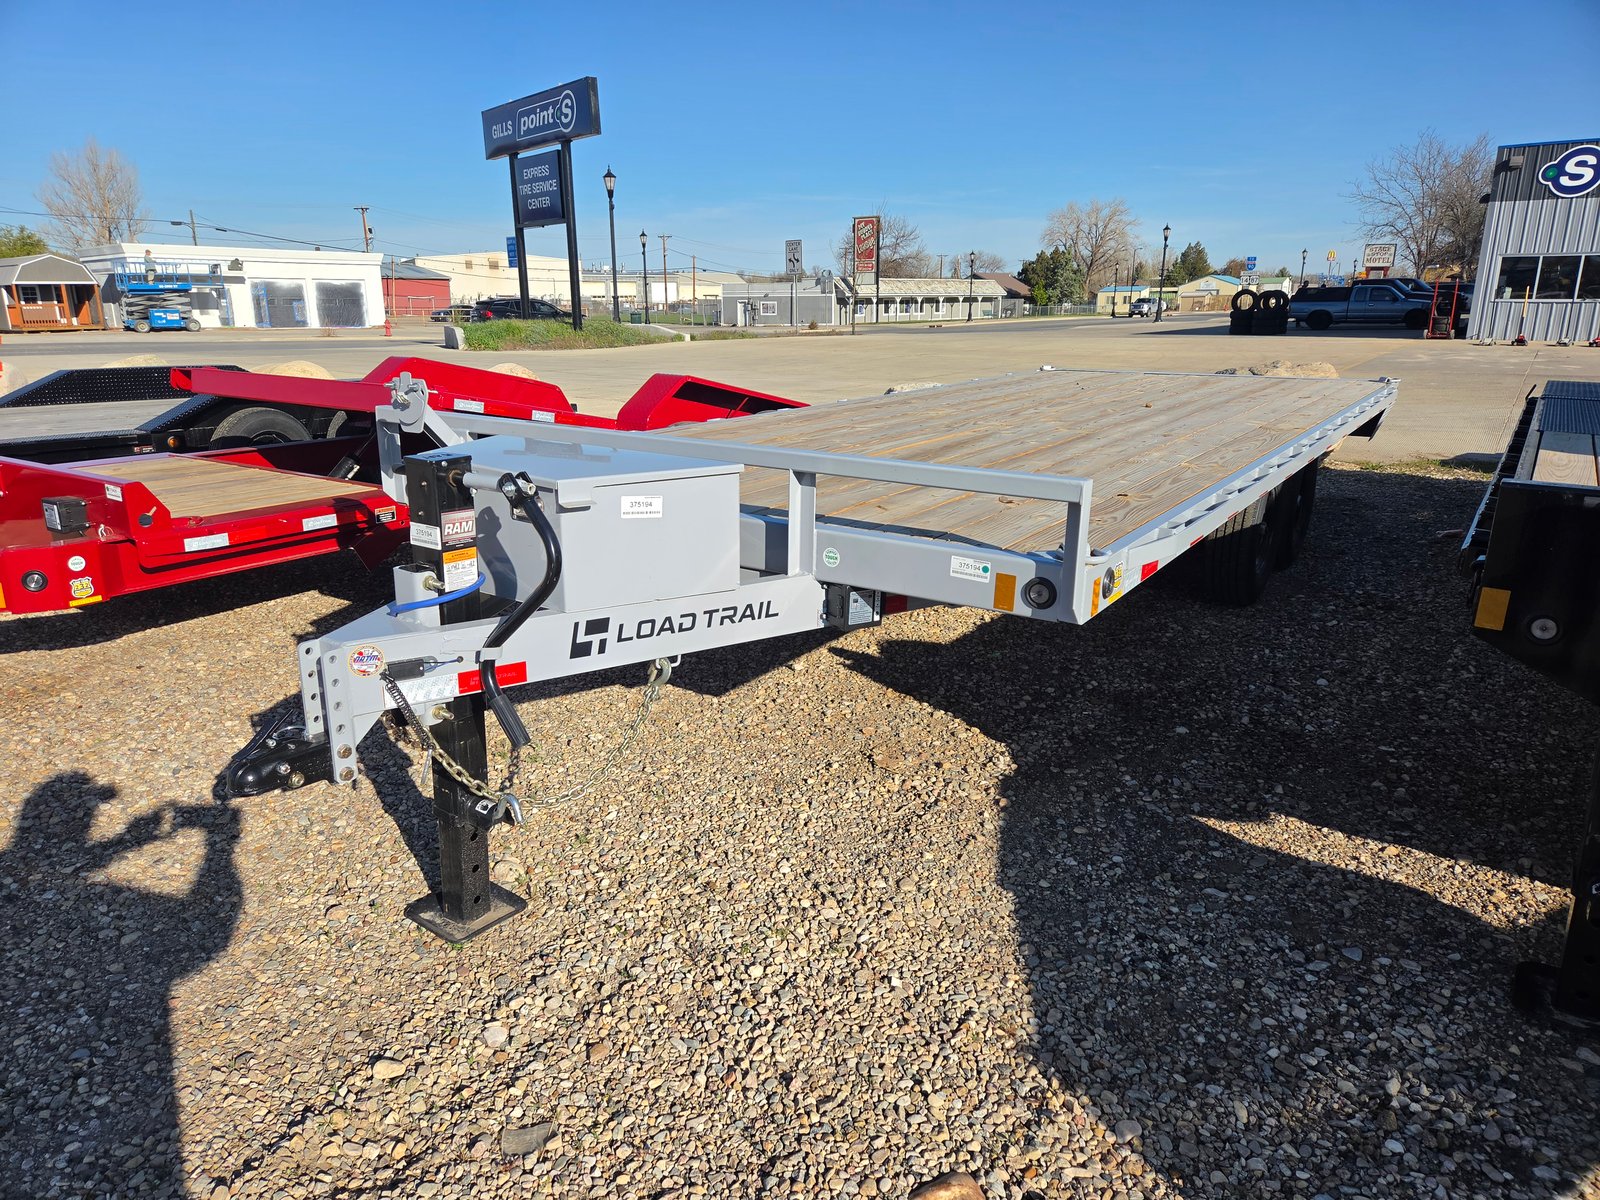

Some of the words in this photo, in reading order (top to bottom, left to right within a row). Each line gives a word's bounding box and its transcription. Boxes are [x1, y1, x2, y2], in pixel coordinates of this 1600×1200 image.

[492, 121, 512, 138] GILLS
[521, 105, 554, 135] point
[561, 99, 572, 123] S
[523, 165, 549, 179] EXPRESS
[1559, 154, 1597, 187] S
[519, 184, 531, 195] TIRE
[532, 180, 557, 193] SERVICE
[528, 197, 550, 209] CENTER
[445, 521, 472, 535] RAM
[958, 561, 981, 571] 375194
[617, 612, 697, 643] LOAD
[703, 600, 779, 629] TRAIL
